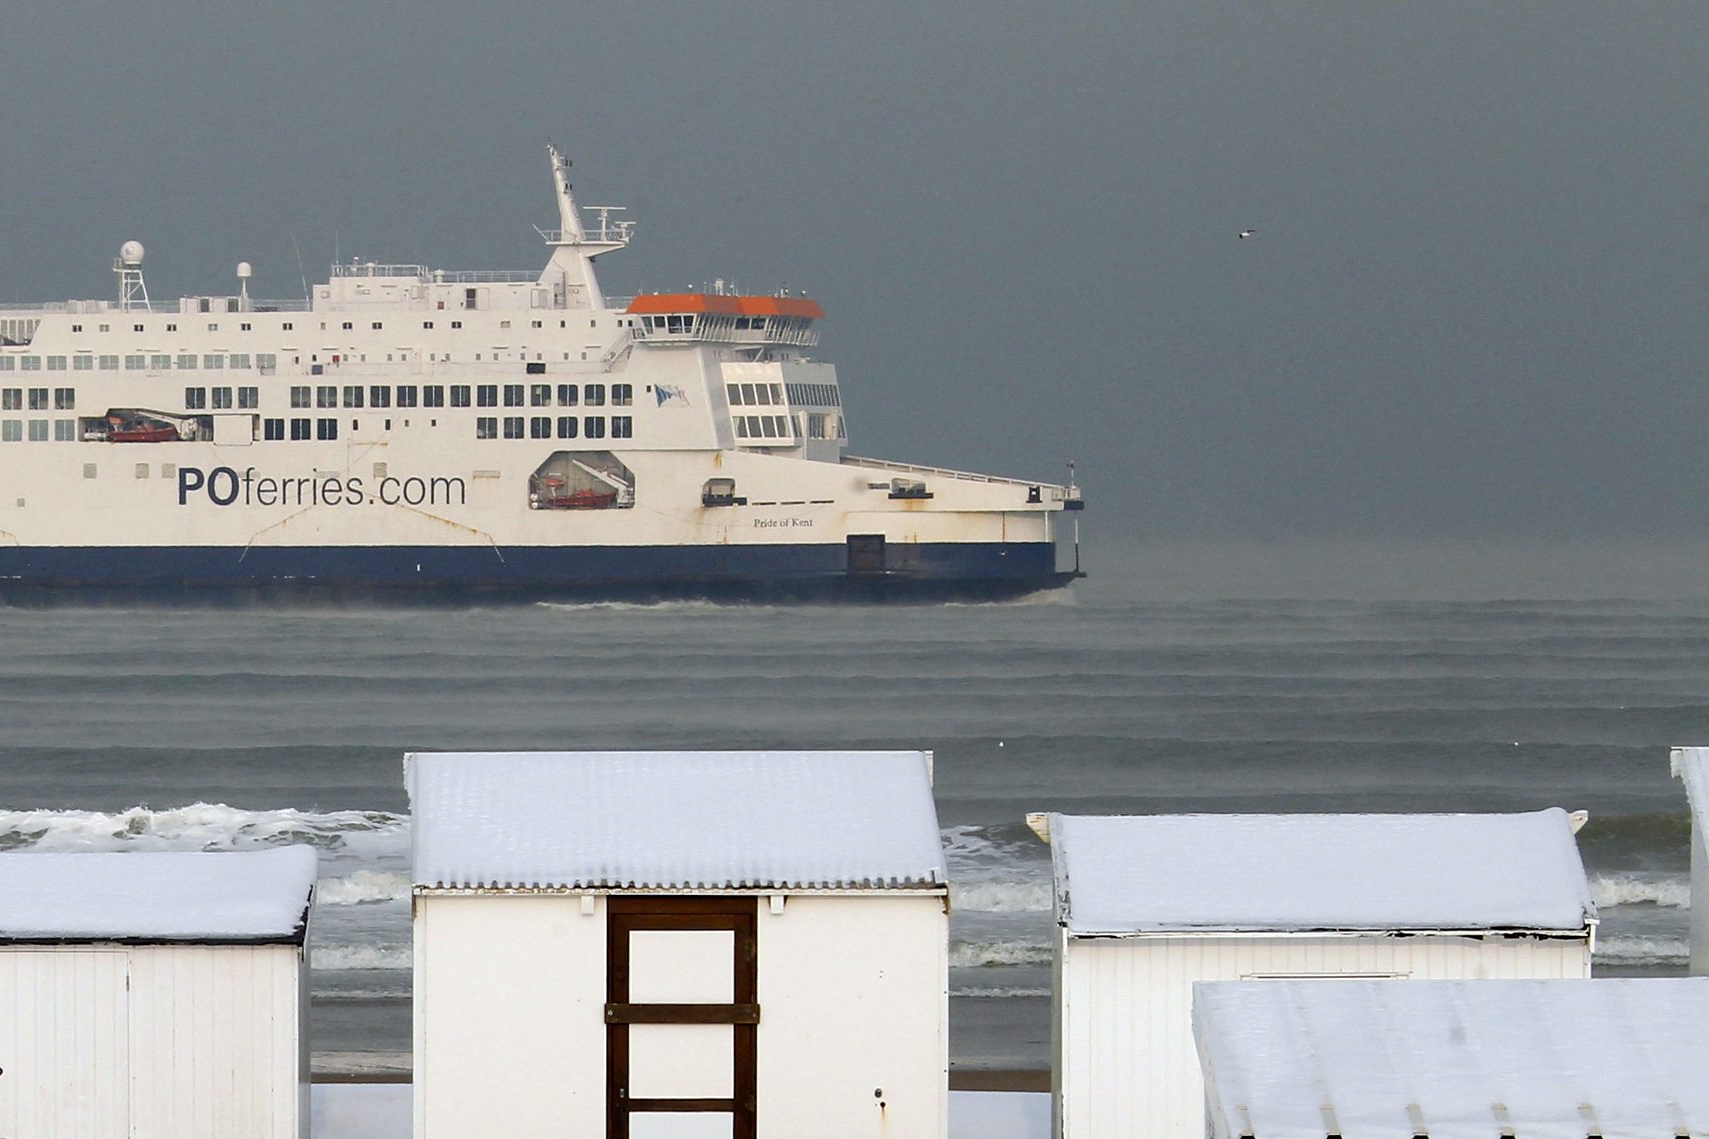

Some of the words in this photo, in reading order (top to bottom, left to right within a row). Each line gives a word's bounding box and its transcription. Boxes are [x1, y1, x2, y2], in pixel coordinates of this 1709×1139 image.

[178, 466, 466, 506] POferries.com
[754, 518, 777, 528] Pride
[779, 518, 790, 528] of
[792, 518, 813, 528] Kent
